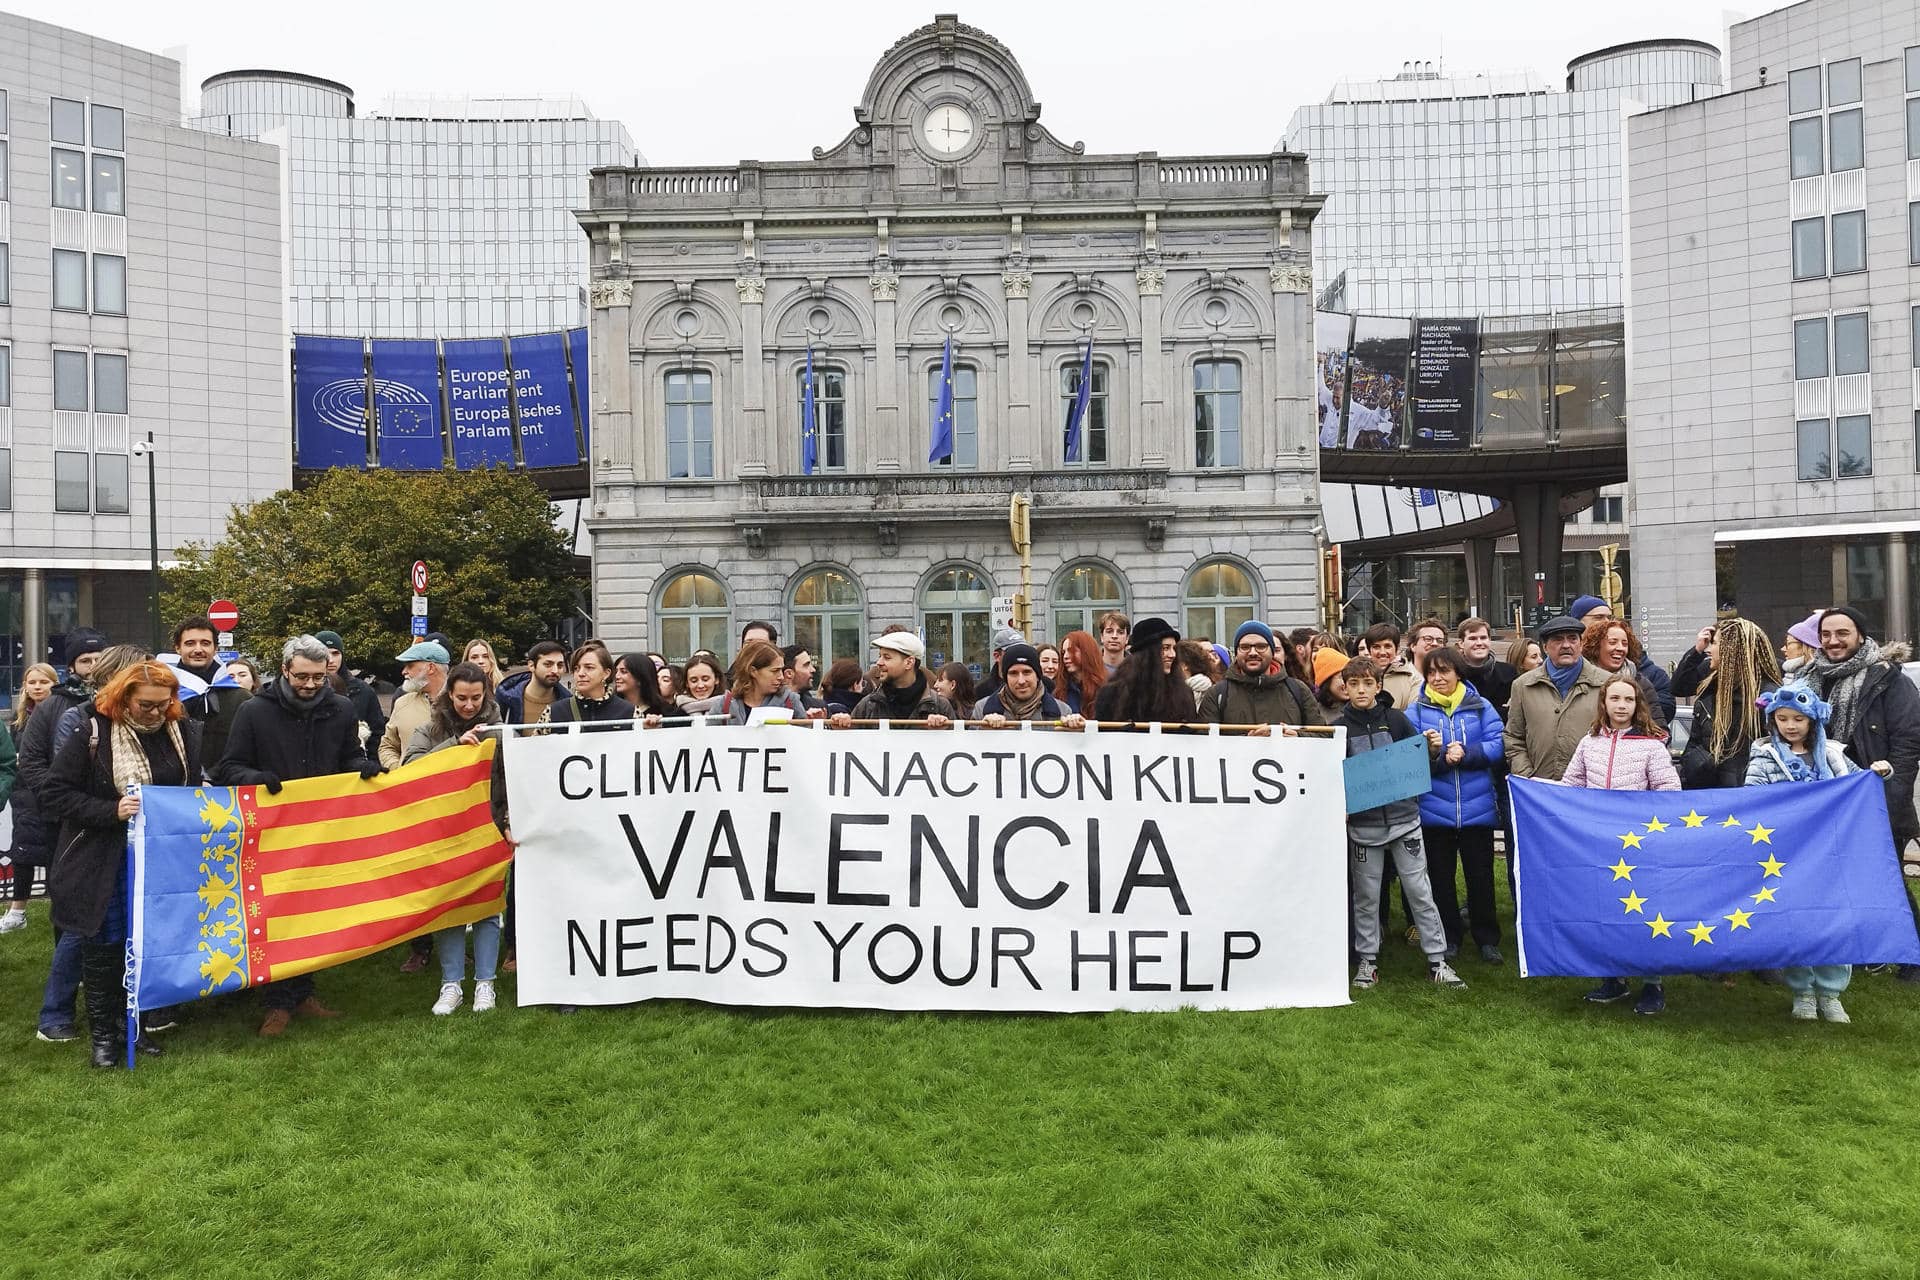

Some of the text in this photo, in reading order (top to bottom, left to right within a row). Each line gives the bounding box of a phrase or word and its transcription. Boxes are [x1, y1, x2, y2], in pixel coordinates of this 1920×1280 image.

[450, 368, 531, 384] European
[452, 383, 544, 401] Parliament
[454, 403, 562, 422] Europäisches
[456, 422, 544, 439] Parlament
[559, 748, 789, 800] CLIMATE
[829, 751, 1112, 801] INACTION
[1133, 755, 1305, 804] KILLS:
[618, 810, 1192, 916] VALENCIA
[567, 914, 1261, 992] NEEDS YOUR HELP
